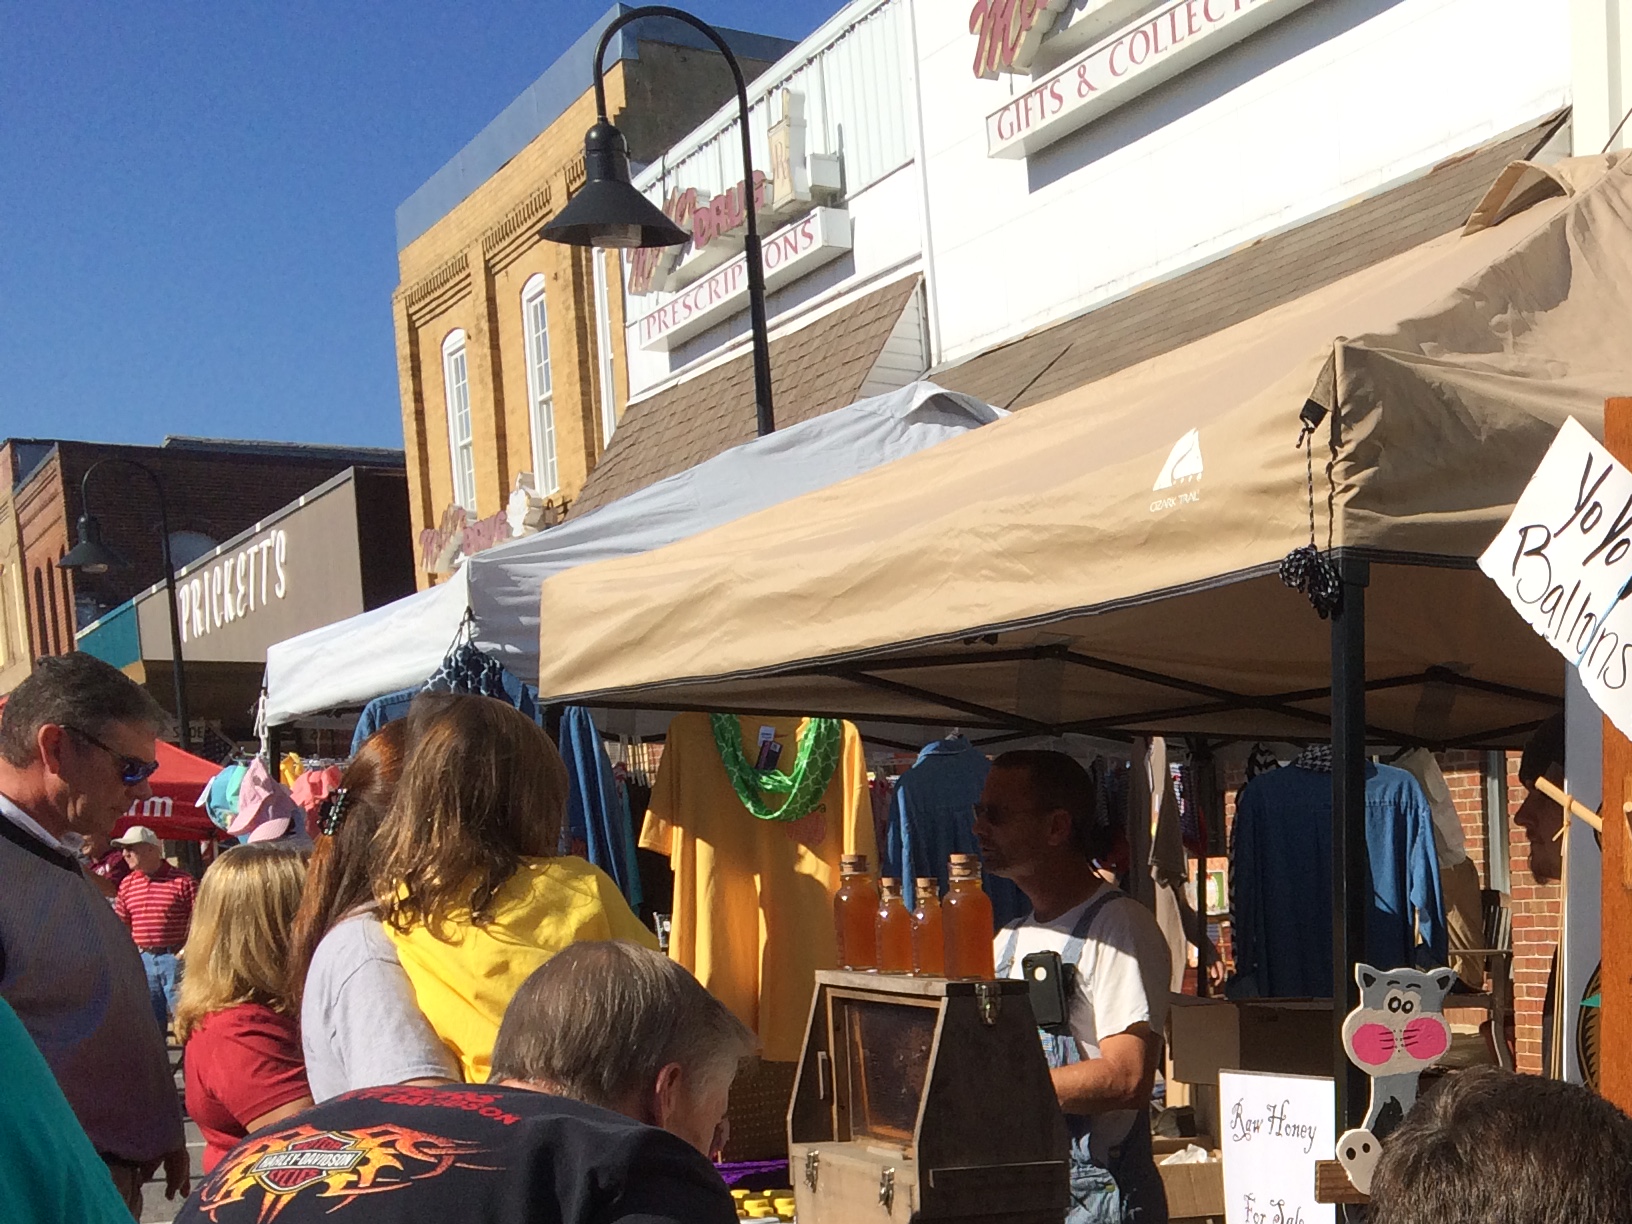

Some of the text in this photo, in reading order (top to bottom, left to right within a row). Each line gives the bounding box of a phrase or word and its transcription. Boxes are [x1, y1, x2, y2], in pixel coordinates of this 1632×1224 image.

[997, 78, 1064, 141] GIFTS
[1077, 64, 1098, 98] &
[646, 218, 815, 342] PRESCRIPONS
[1149, 496, 1177, 512] OZARK
[179, 529, 288, 644] PRICKETT'S
[1230, 1097, 1318, 1155] Raw Honey
[259, 1152, 356, 1169] HARLEY-DAVIDSON
